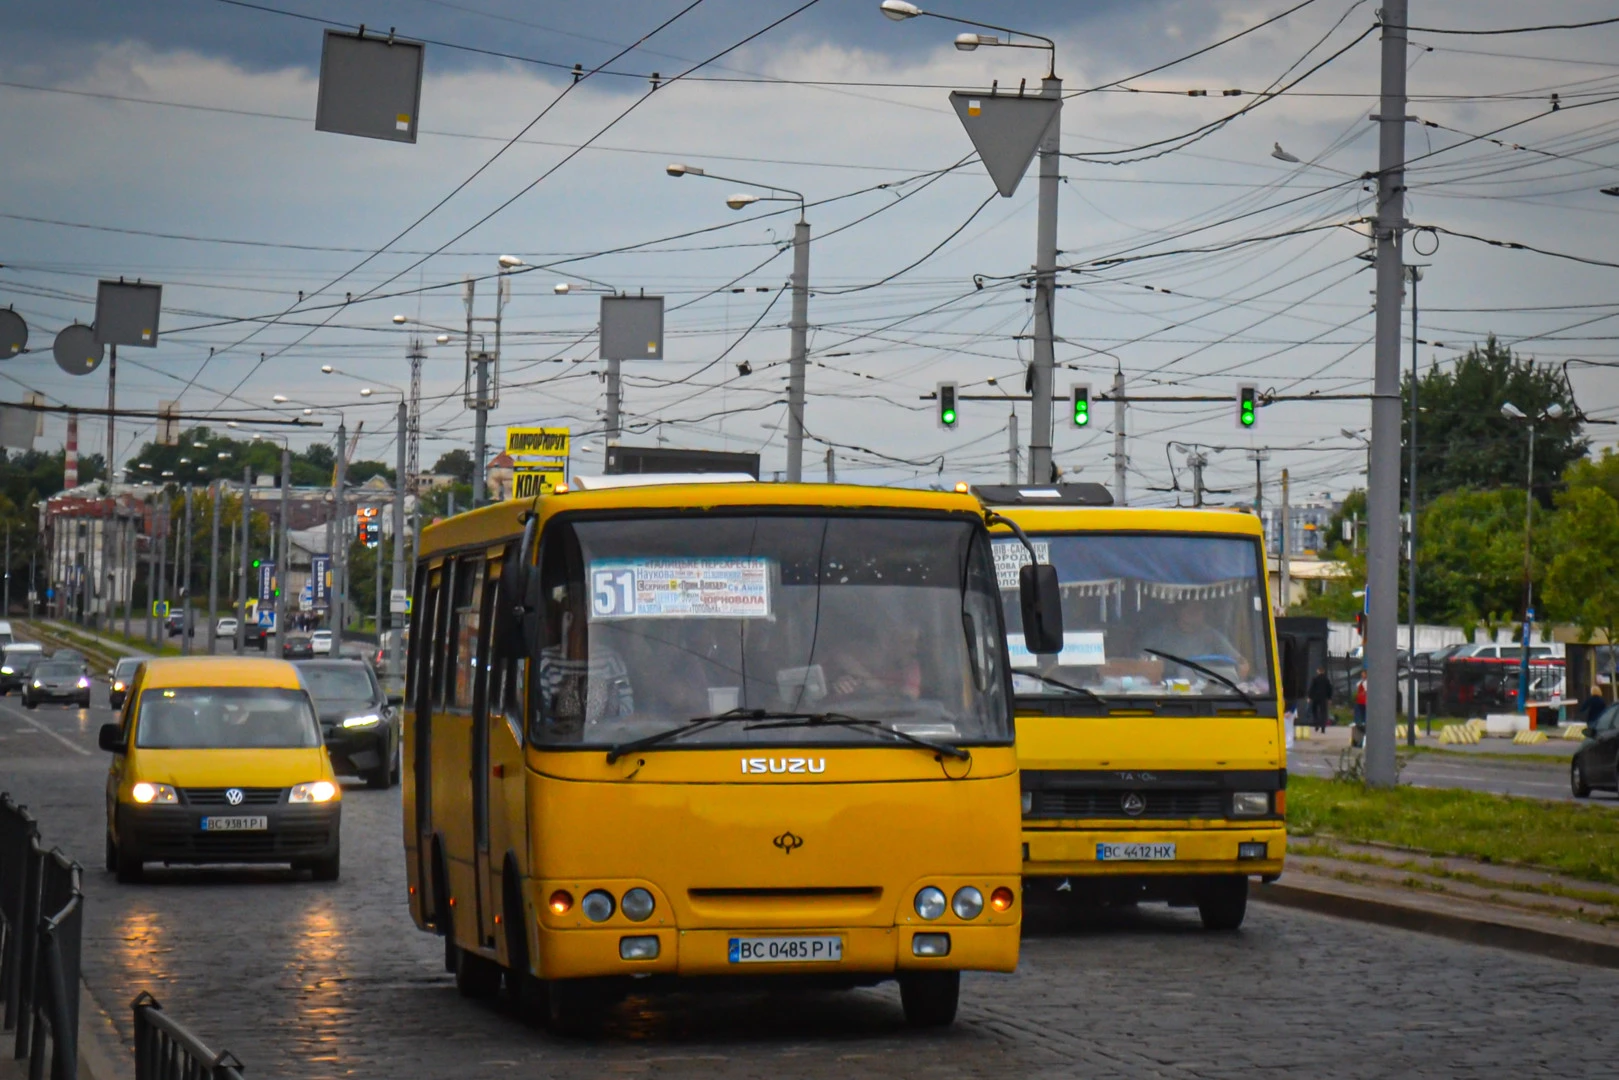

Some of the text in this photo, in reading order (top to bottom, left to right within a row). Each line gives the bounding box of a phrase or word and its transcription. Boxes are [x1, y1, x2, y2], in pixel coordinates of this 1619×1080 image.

[994, 554, 1045, 562] ОРОДК
[637, 568, 674, 580] Наукова
[594, 572, 634, 614] 51
[700, 595, 764, 605] ЧОРНОВОЛА
[741, 757, 826, 774] ISUZU
[225, 818, 248, 829] 9381
[1103, 846, 1171, 858] BC 4412 HX
[740, 942, 765, 958] BC
[769, 941, 808, 958] 0485
